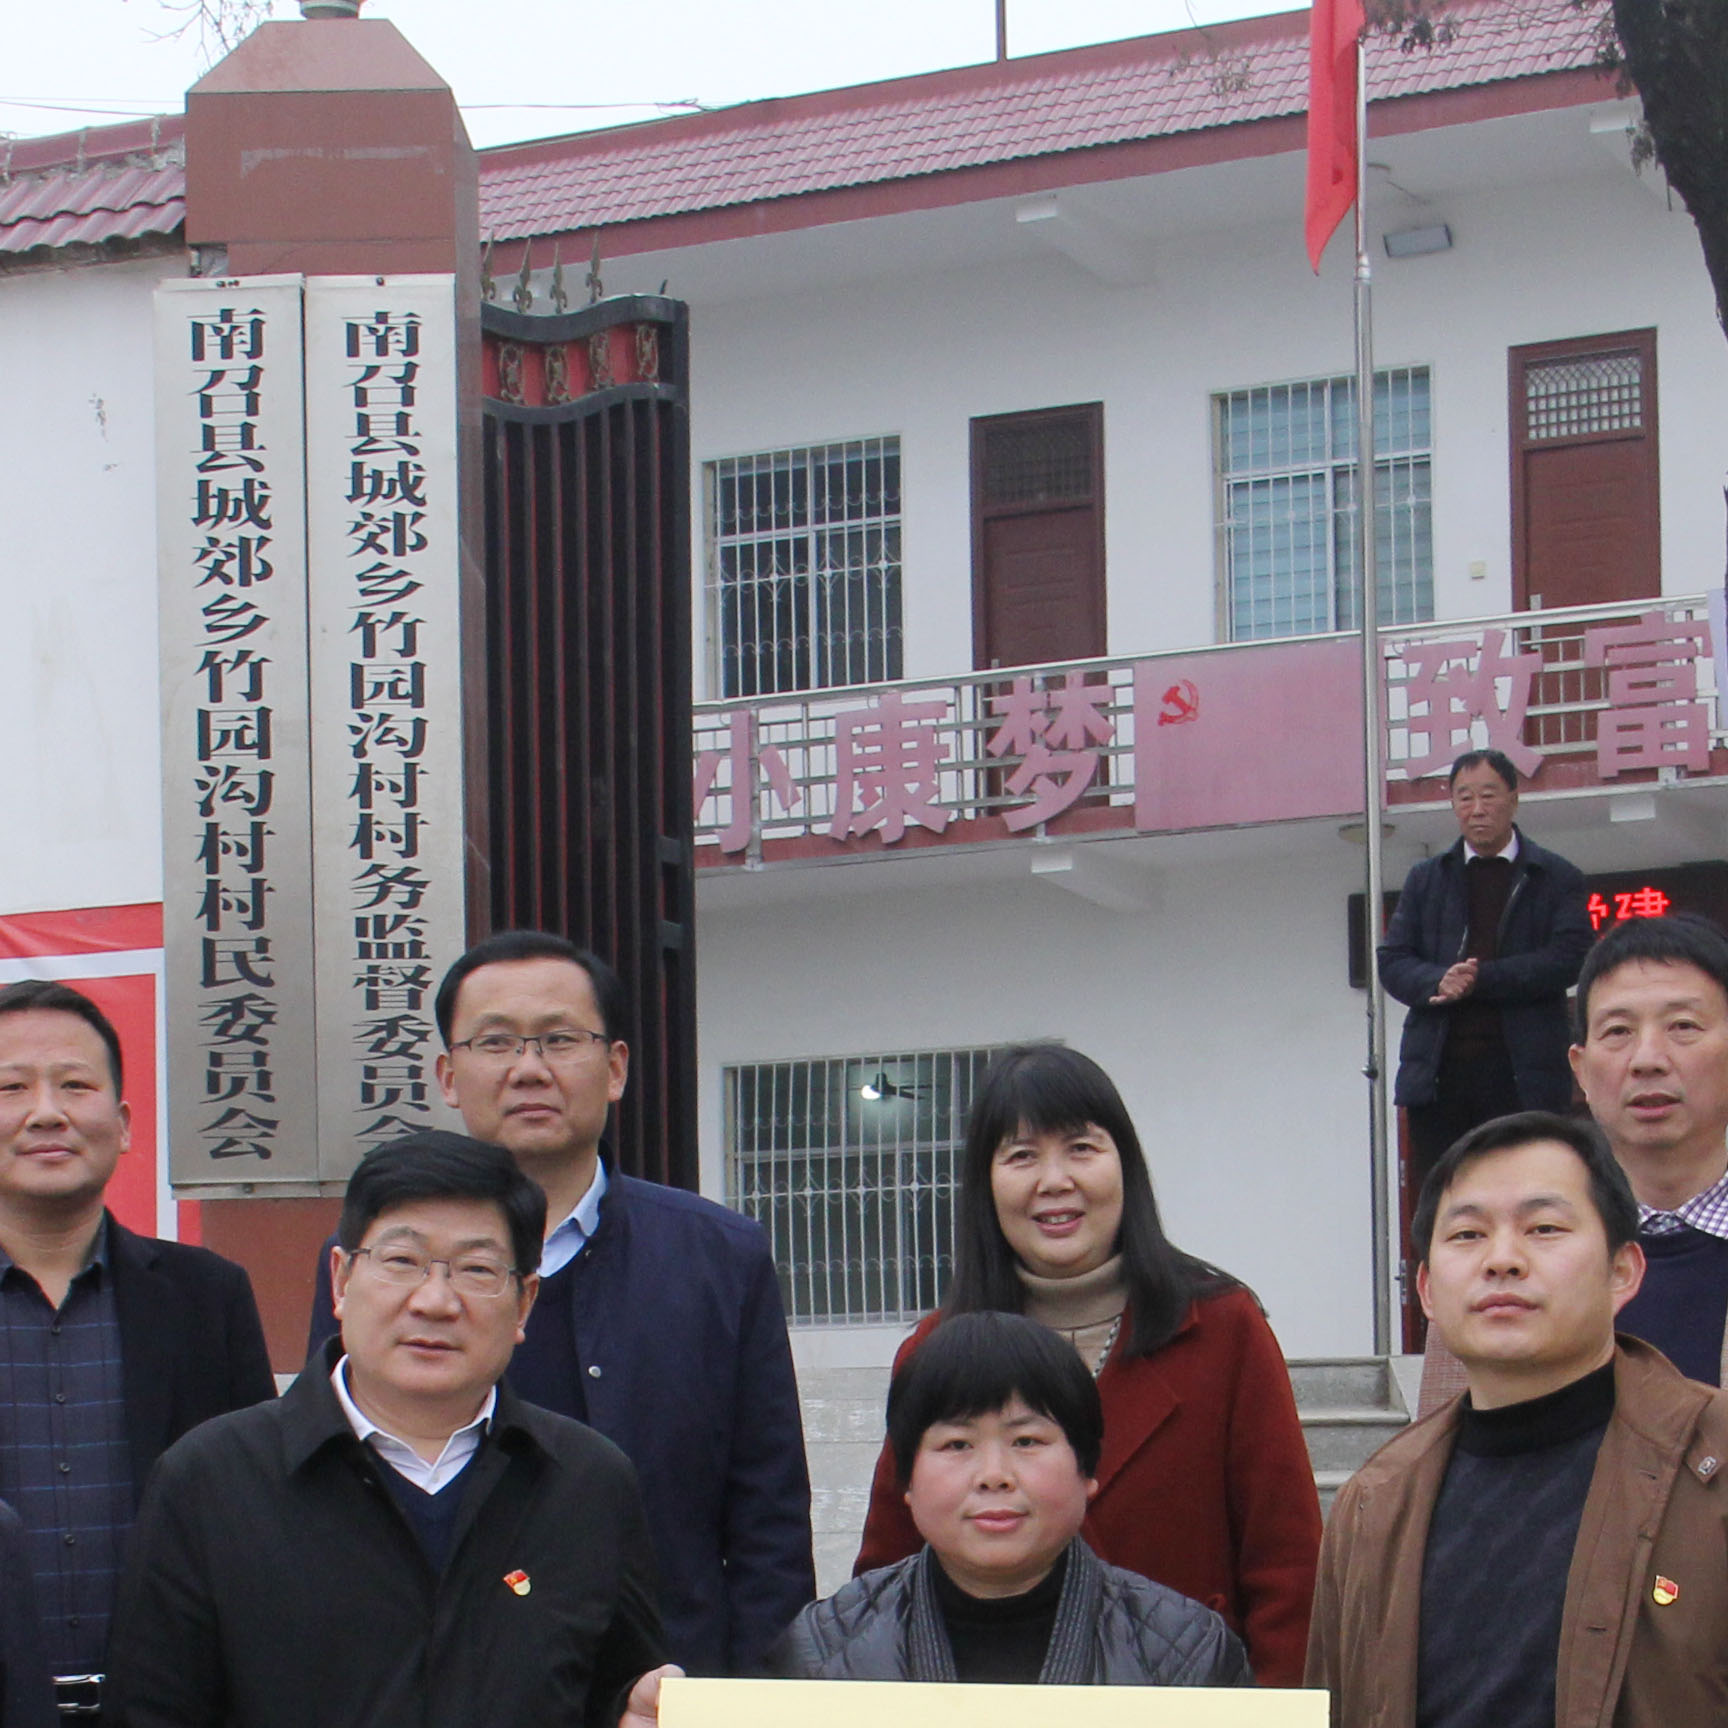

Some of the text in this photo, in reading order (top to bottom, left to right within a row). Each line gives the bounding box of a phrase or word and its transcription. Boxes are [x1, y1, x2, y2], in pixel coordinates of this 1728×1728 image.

[186, 308, 281, 1160] 南召县城郊乡竹园沟村村民委员会
[693, 610, 1713, 855] 小康梦 致富
